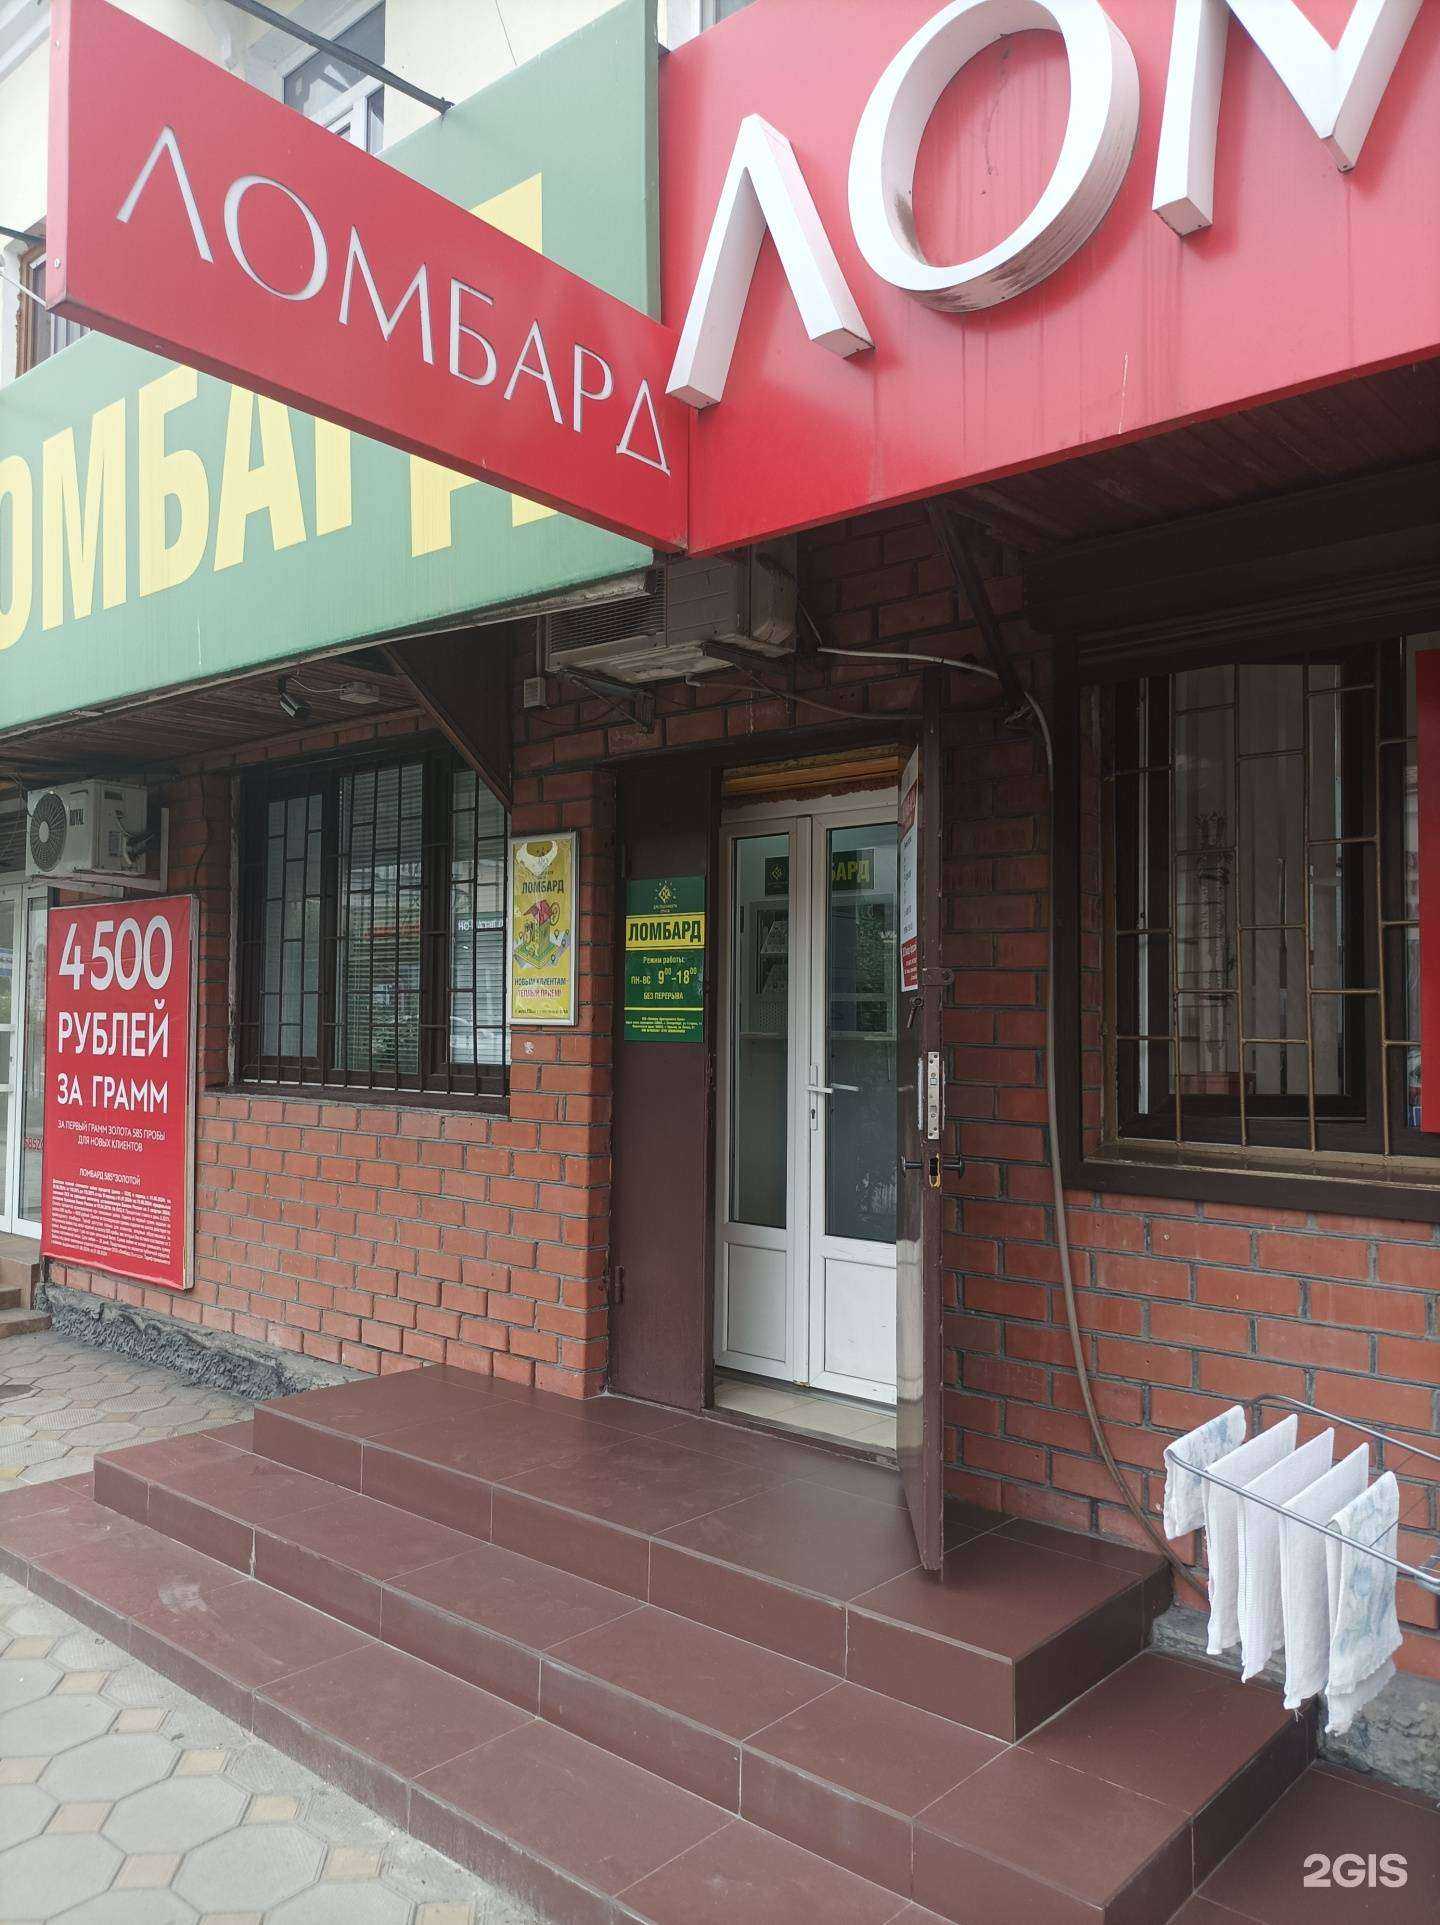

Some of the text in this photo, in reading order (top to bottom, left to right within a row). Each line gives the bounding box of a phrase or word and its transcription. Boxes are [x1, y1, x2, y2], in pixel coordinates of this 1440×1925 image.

[116, 125, 671, 477] ЛОМБАРД
[522, 879, 565, 894] ЛОМБАРД
[628, 920, 702, 943] ЛОМБАРД
[643, 991, 684, 1000] БЕЗ ПЕРЕРЫВА
[57, 998, 169, 1058] РУБЛЕЙ
[57, 1073, 168, 1114] ЗА ГРАММ
[57, 1120, 166, 1141] ЗА ПЕРВЫЙ ГРАММ ЗОЛОТА 585 ПРОБЫ
[78, 1135, 143, 1152] ДЛЯ НОВЫХ КЛИЕНТОВ
[80, 1168, 104, 1181] ЛОМБАРД
